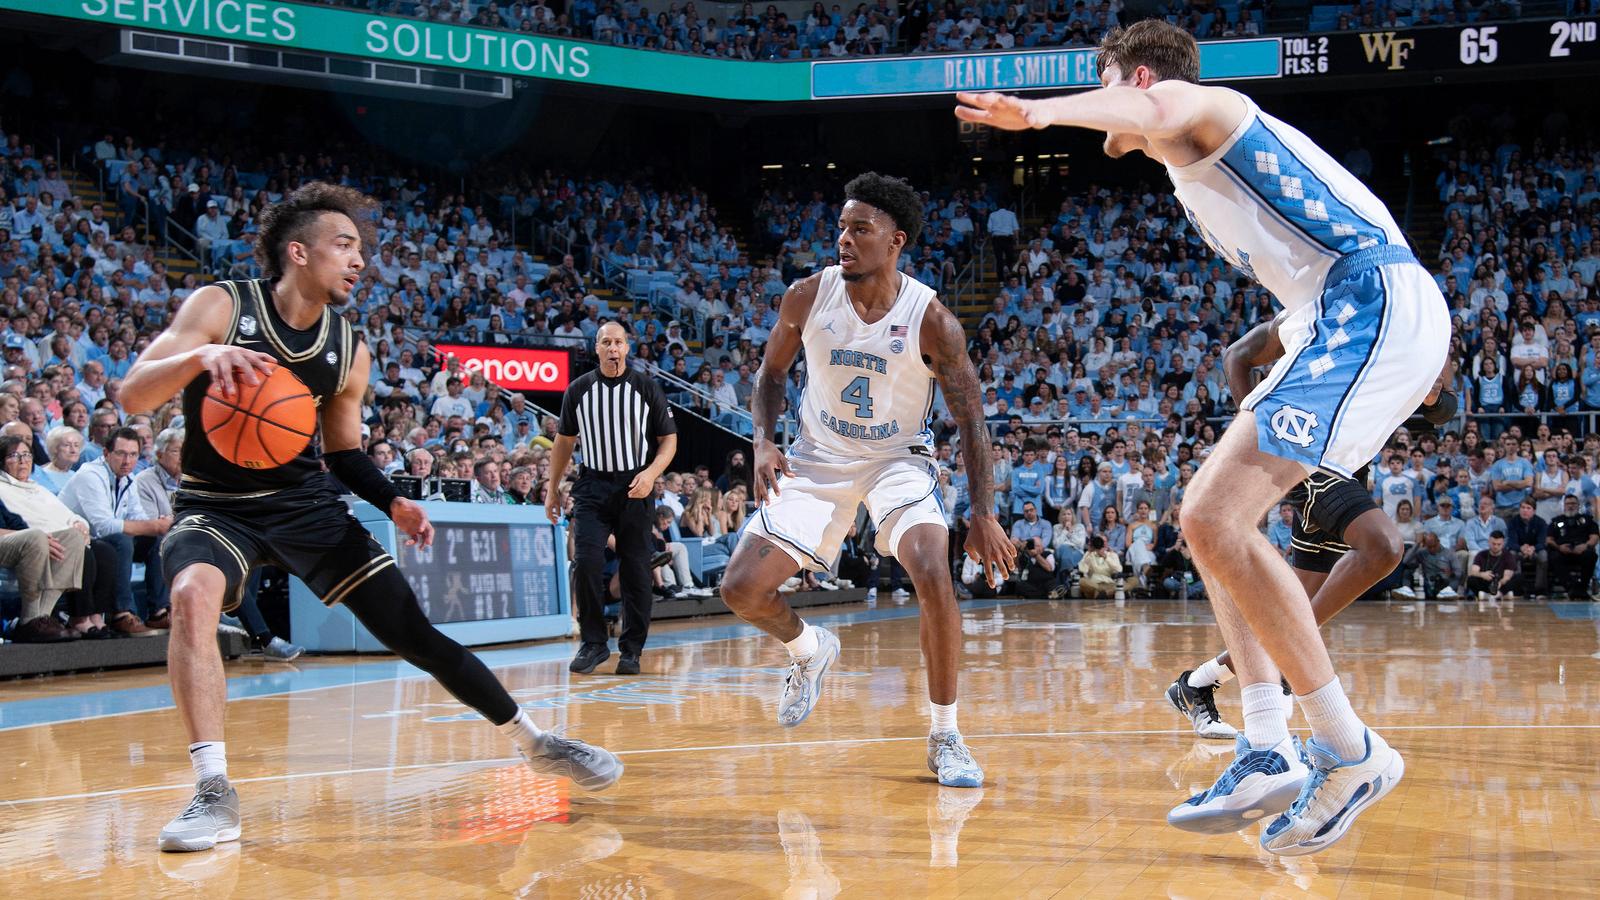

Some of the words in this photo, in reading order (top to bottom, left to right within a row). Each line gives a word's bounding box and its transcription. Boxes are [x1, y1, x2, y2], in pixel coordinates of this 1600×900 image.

[366, 20, 590, 77] SOLUTIONS
[1284, 38, 1316, 55] TOL:
[1318, 37, 1329, 54] 2
[1460, 26, 1498, 64] 65
[1549, 21, 1597, 57] 2ND
[944, 58, 986, 88] DEAN
[993, 58, 1008, 86] E.
[1014, 54, 1068, 85] SMITH
[1075, 52, 1101, 82] CE
[1284, 57, 1315, 75] FLS:
[1317, 56, 1329, 73] 6
[830, 349, 888, 375] NORTH
[841, 376, 874, 419] 4
[820, 410, 899, 440] CAROLINA
[470, 530, 497, 562] 6:31
